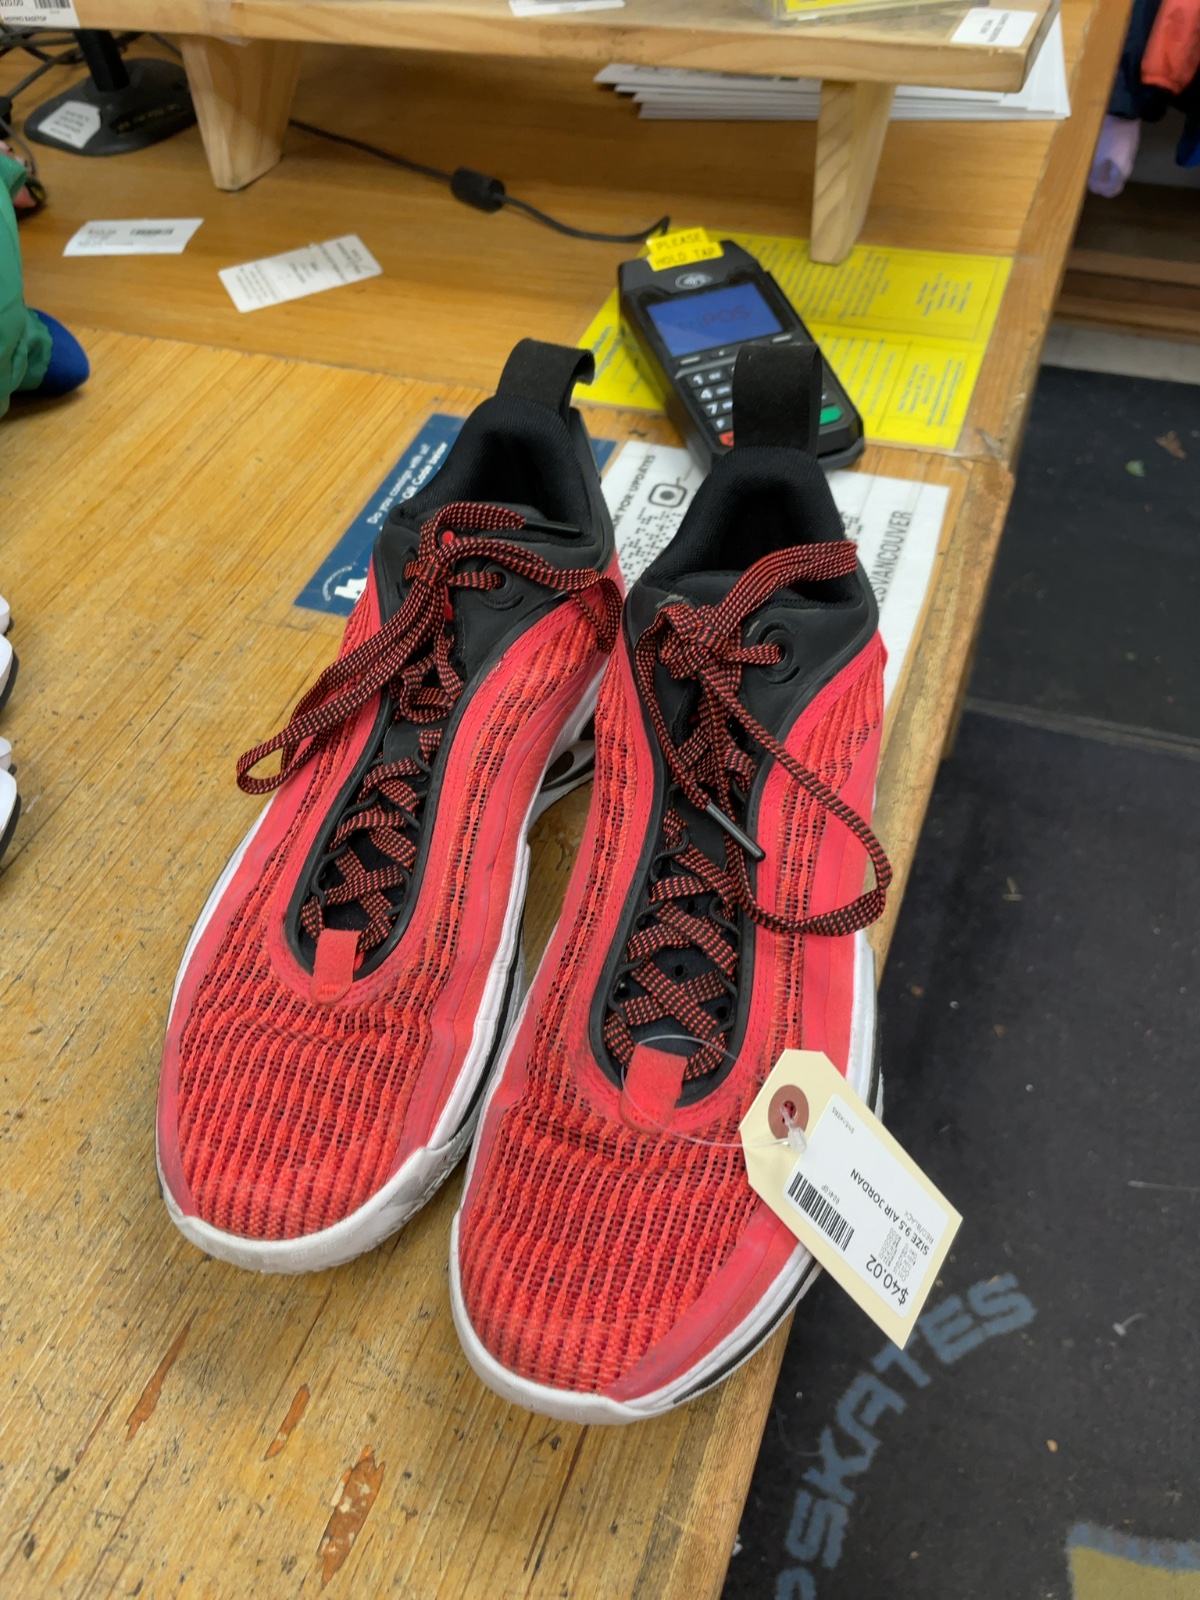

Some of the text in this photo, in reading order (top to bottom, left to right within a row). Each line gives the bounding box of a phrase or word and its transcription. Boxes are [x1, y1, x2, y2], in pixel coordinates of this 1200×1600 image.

[655, 232, 702, 252] PLEASE
[656, 246, 716, 267] HOLD TAP
[701, 388, 713, 400] 4
[706, 402, 718, 415] 7
[411, 465, 433, 486] Code
[618, 493, 635, 513] FOR
[630, 454, 656, 492] UPDATES
[870, 510, 913, 607] ESVANCOUVER
[851, 1169, 930, 1256] SIZE 9.5 AIR JORDAN
[905, 1211, 935, 1245] RED/BLACK
[866, 1255, 909, 1305] $40.02
